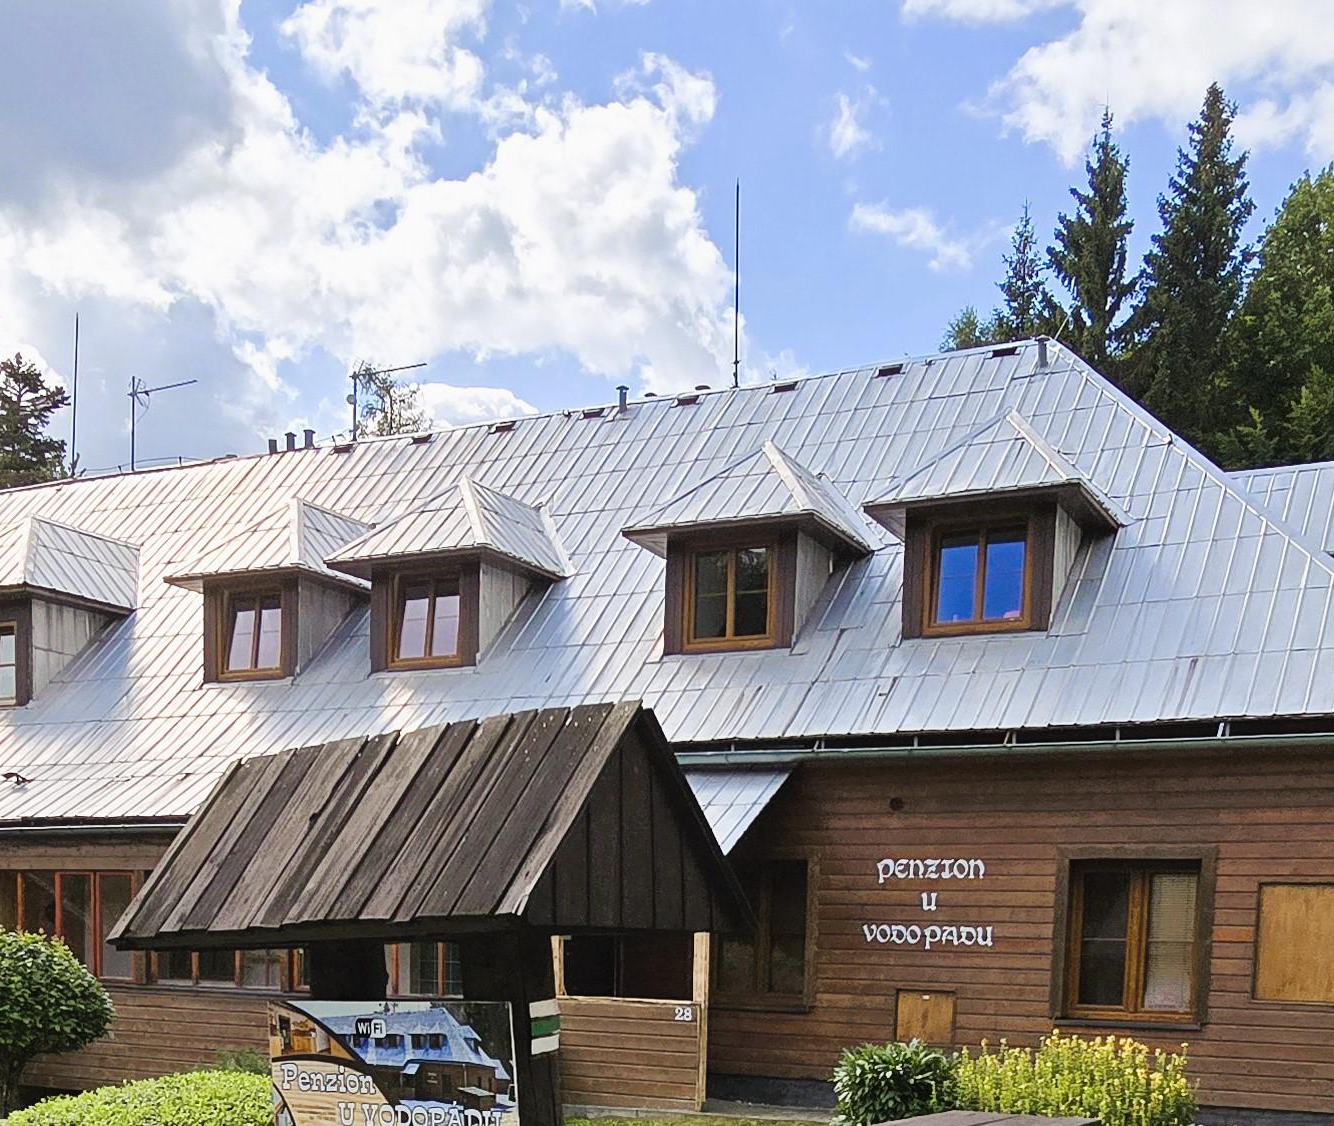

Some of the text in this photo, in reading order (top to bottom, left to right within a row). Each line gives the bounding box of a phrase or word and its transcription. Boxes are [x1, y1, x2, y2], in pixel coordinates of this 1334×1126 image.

[674, 1007, 693, 1021] 28
[281, 1063, 376, 1095] Penzion
[338, 1102, 355, 1126] U
